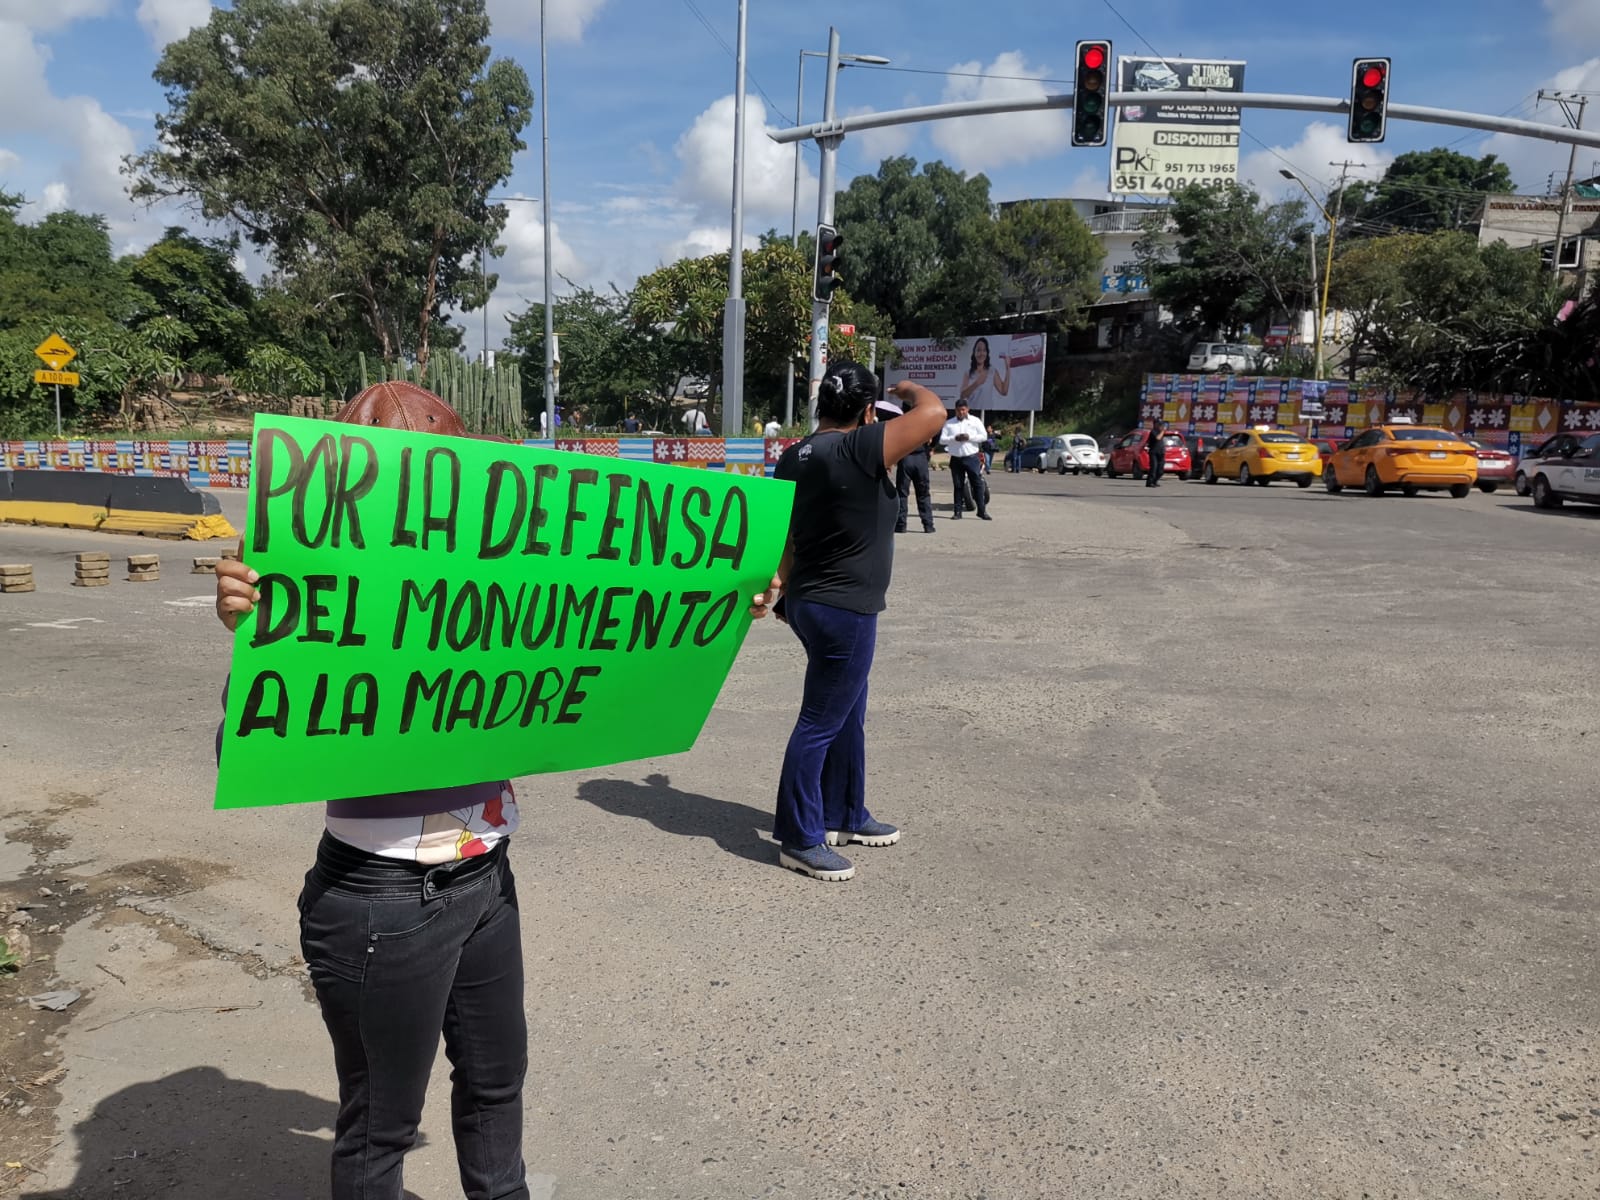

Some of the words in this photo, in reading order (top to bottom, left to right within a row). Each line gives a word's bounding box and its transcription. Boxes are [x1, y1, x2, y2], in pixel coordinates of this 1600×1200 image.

[1202, 65, 1230, 79] TOMAS
[1157, 132, 1238, 145] DISPONIBLE
[1165, 163, 1183, 173] 951
[1187, 164, 1205, 173] 713
[1209, 164, 1235, 173] 1965
[1116, 176, 1144, 190] 951
[916, 345, 926, 353] NO
[253, 427, 380, 553] POR
[389, 446, 461, 553] LA
[477, 460, 748, 570] DEFENSA
[250, 572, 366, 648] DEL
[392, 576, 739, 652] MONUMENTO
[237, 669, 290, 738] A
[306, 671, 379, 737] LA
[400, 665, 602, 735] MADRE
